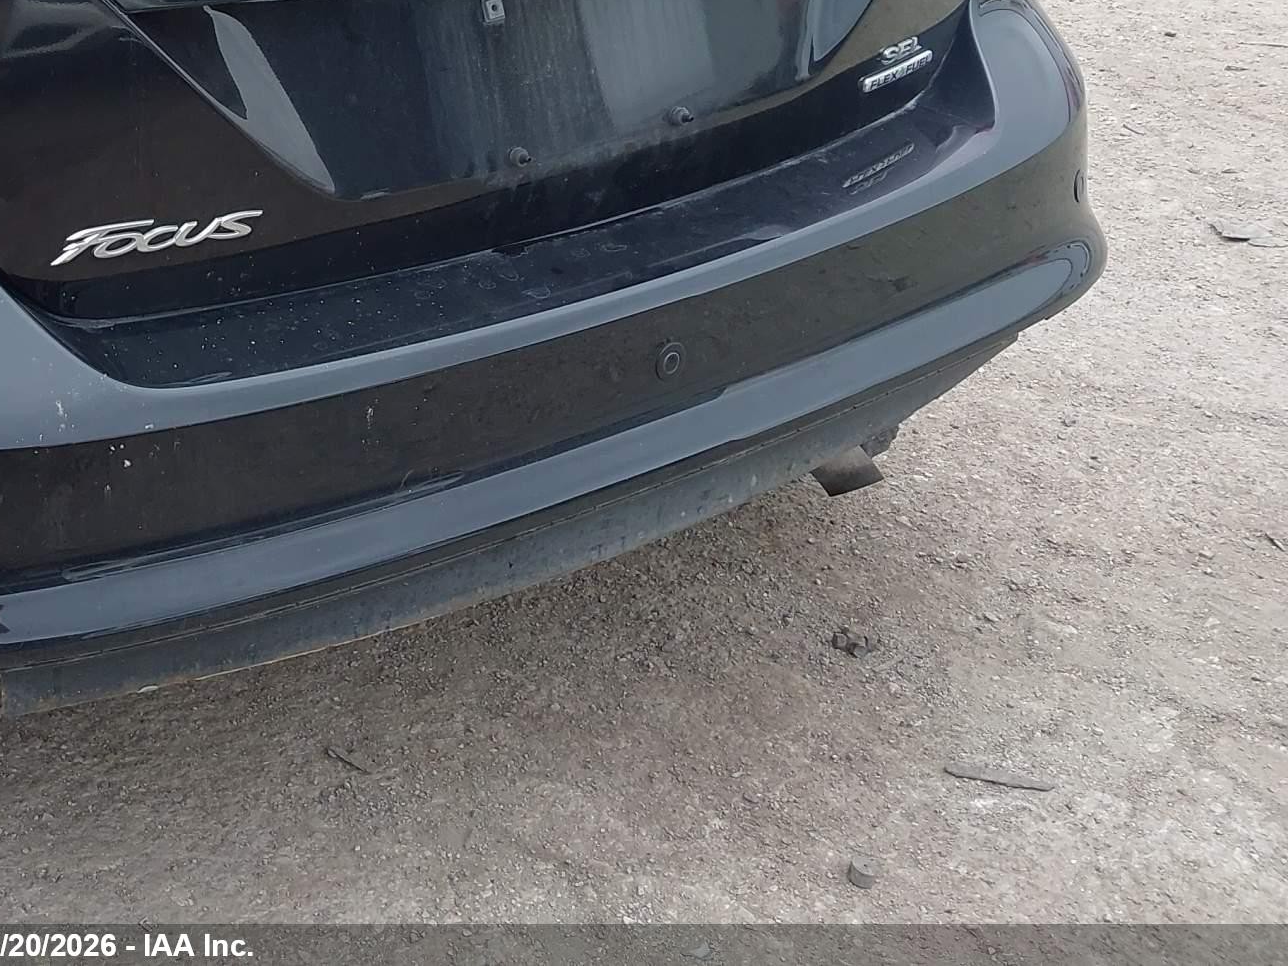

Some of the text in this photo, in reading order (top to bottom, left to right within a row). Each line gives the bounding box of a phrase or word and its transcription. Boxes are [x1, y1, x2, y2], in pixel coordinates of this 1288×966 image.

[881, 36, 922, 65] SEL
[871, 53, 931, 90] FLEX FUEL
[50, 209, 264, 267] FOCUS
